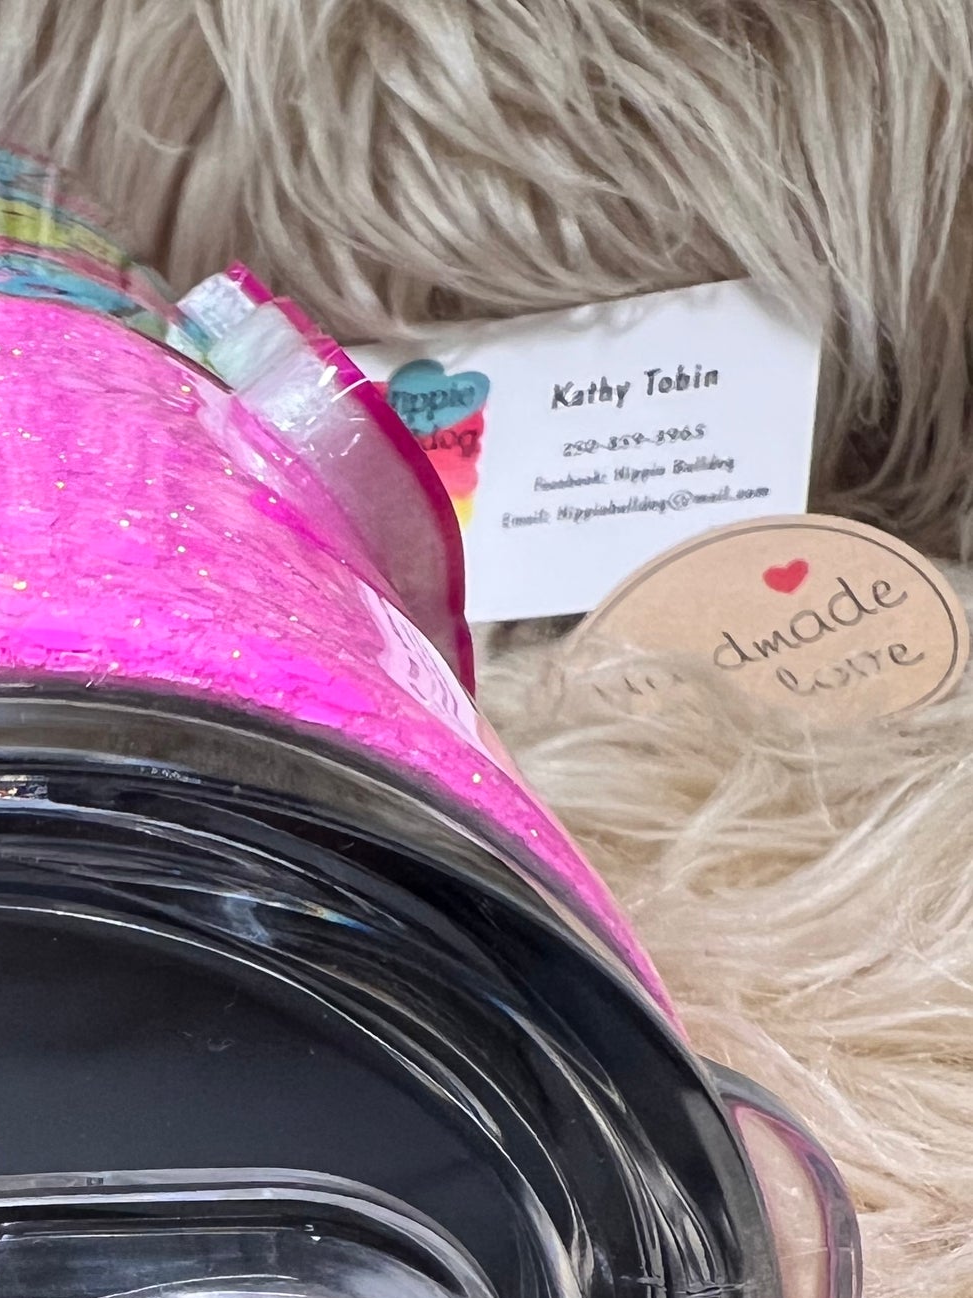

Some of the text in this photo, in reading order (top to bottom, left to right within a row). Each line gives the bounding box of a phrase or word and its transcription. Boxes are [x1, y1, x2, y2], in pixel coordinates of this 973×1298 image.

[551, 364, 719, 409] Kathy Tobin
[713, 577, 908, 670] dmade
